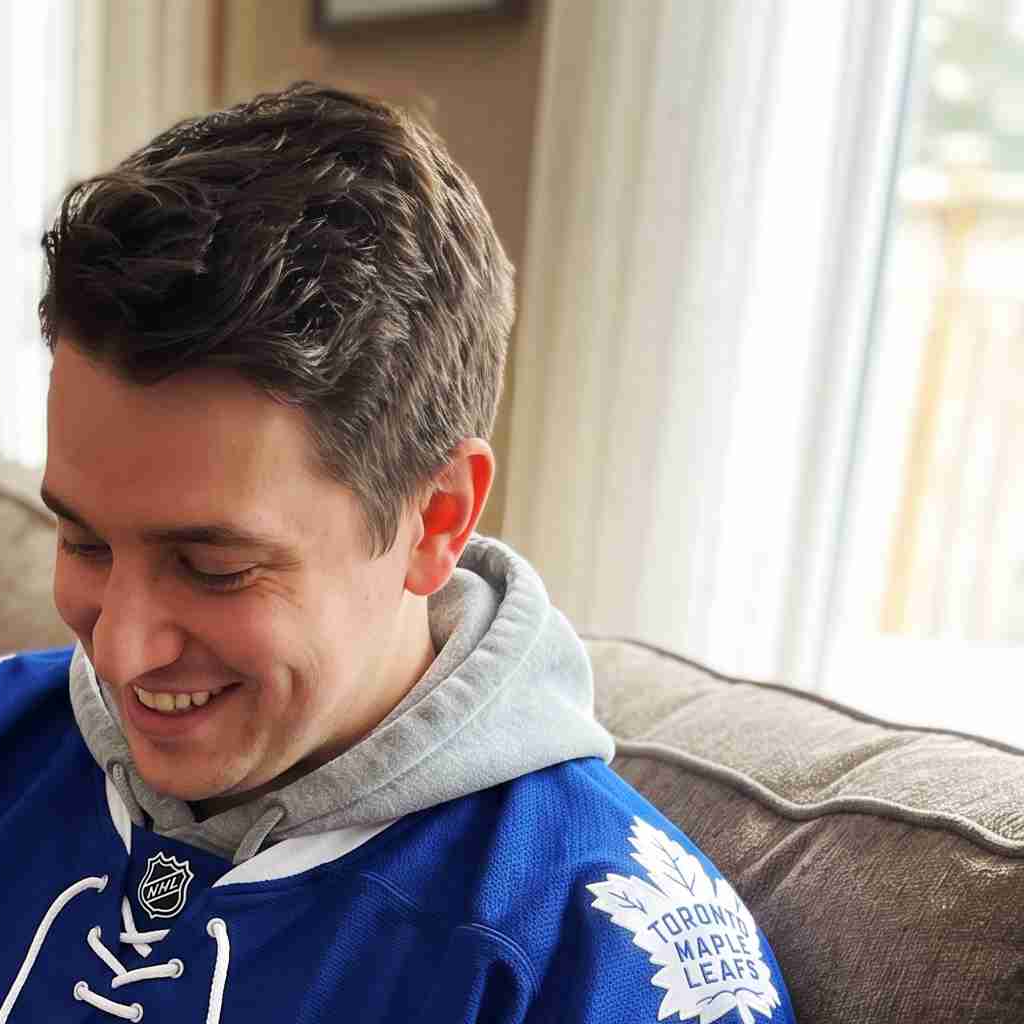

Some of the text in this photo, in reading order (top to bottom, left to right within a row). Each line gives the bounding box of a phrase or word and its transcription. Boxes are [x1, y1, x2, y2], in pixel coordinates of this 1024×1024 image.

[146, 876, 178, 899] NHL
[647, 903, 749, 944] TORONTO
[674, 933, 752, 963] MAPLE
[684, 958, 759, 989] LEAFS
